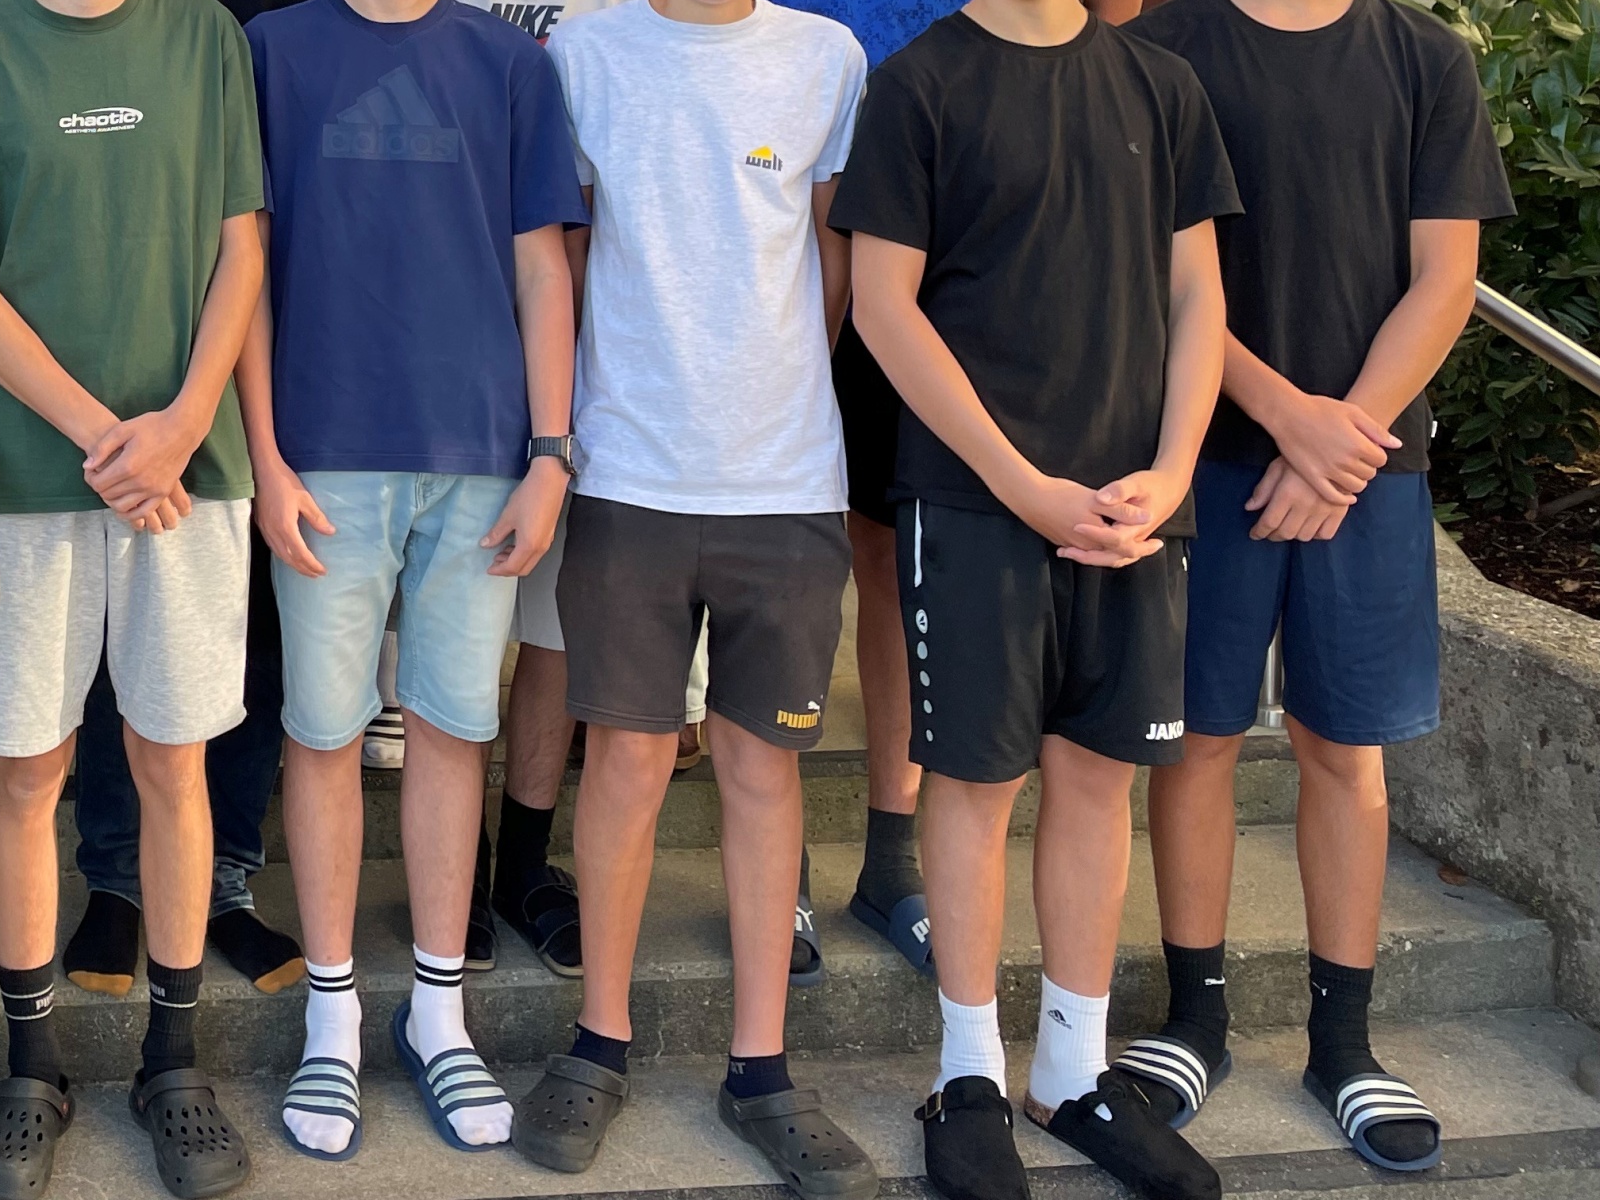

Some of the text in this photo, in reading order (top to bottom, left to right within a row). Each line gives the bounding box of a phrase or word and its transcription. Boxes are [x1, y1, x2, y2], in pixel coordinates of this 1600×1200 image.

[490, 3, 565, 39] NIKE
[59, 109, 138, 128] chaotic
[1145, 720, 1184, 740] JAKO
